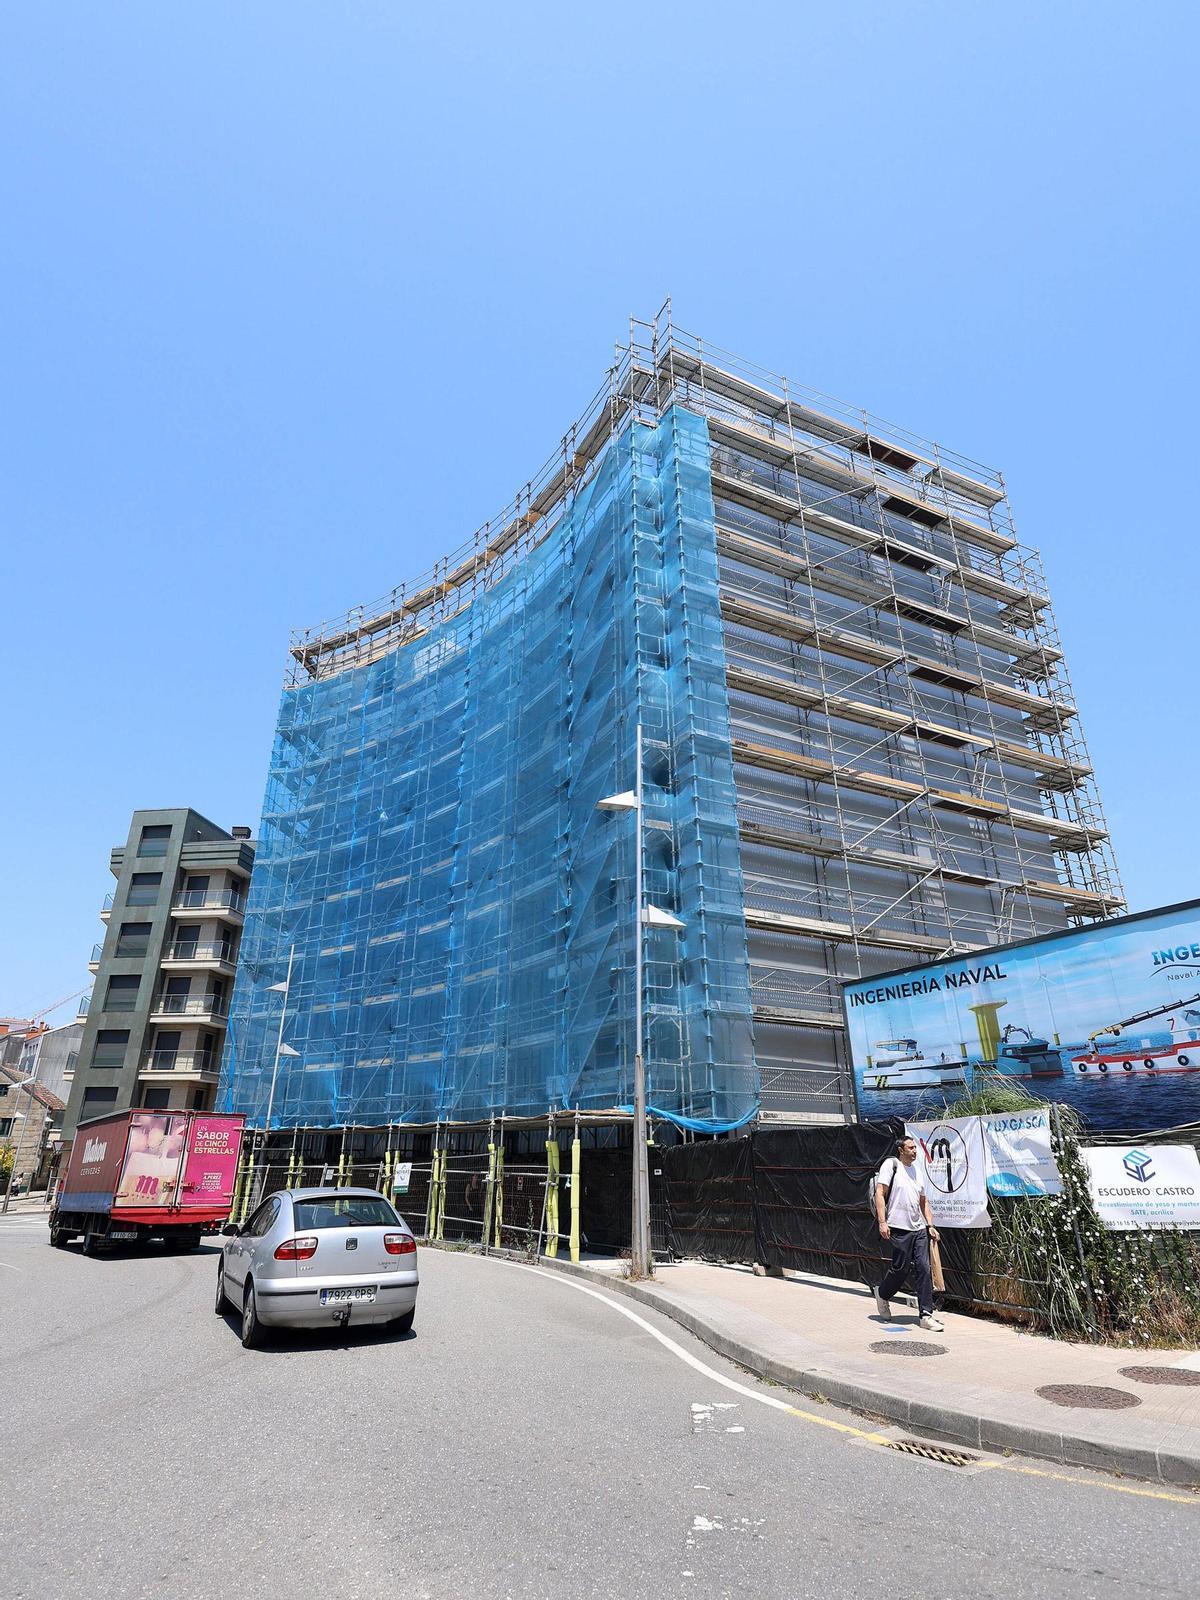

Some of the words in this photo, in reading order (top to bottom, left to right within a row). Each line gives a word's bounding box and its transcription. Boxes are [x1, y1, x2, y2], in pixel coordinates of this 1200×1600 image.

[1151, 943, 1200, 966] INGE
[1167, 970, 1194, 981] Naval
[850, 977, 941, 1007] INGENIERÍA
[944, 964, 1007, 989] NAVAL
[196, 1131, 230, 1140] SABOR
[194, 1147, 235, 1155] ESTRELLAS
[1098, 1187, 1151, 1197] ESCUDERO
[1156, 1187, 1195, 1196] CASTRO
[328, 1290, 352, 1301] 7922
[354, 1288, 372, 1299] CPS
